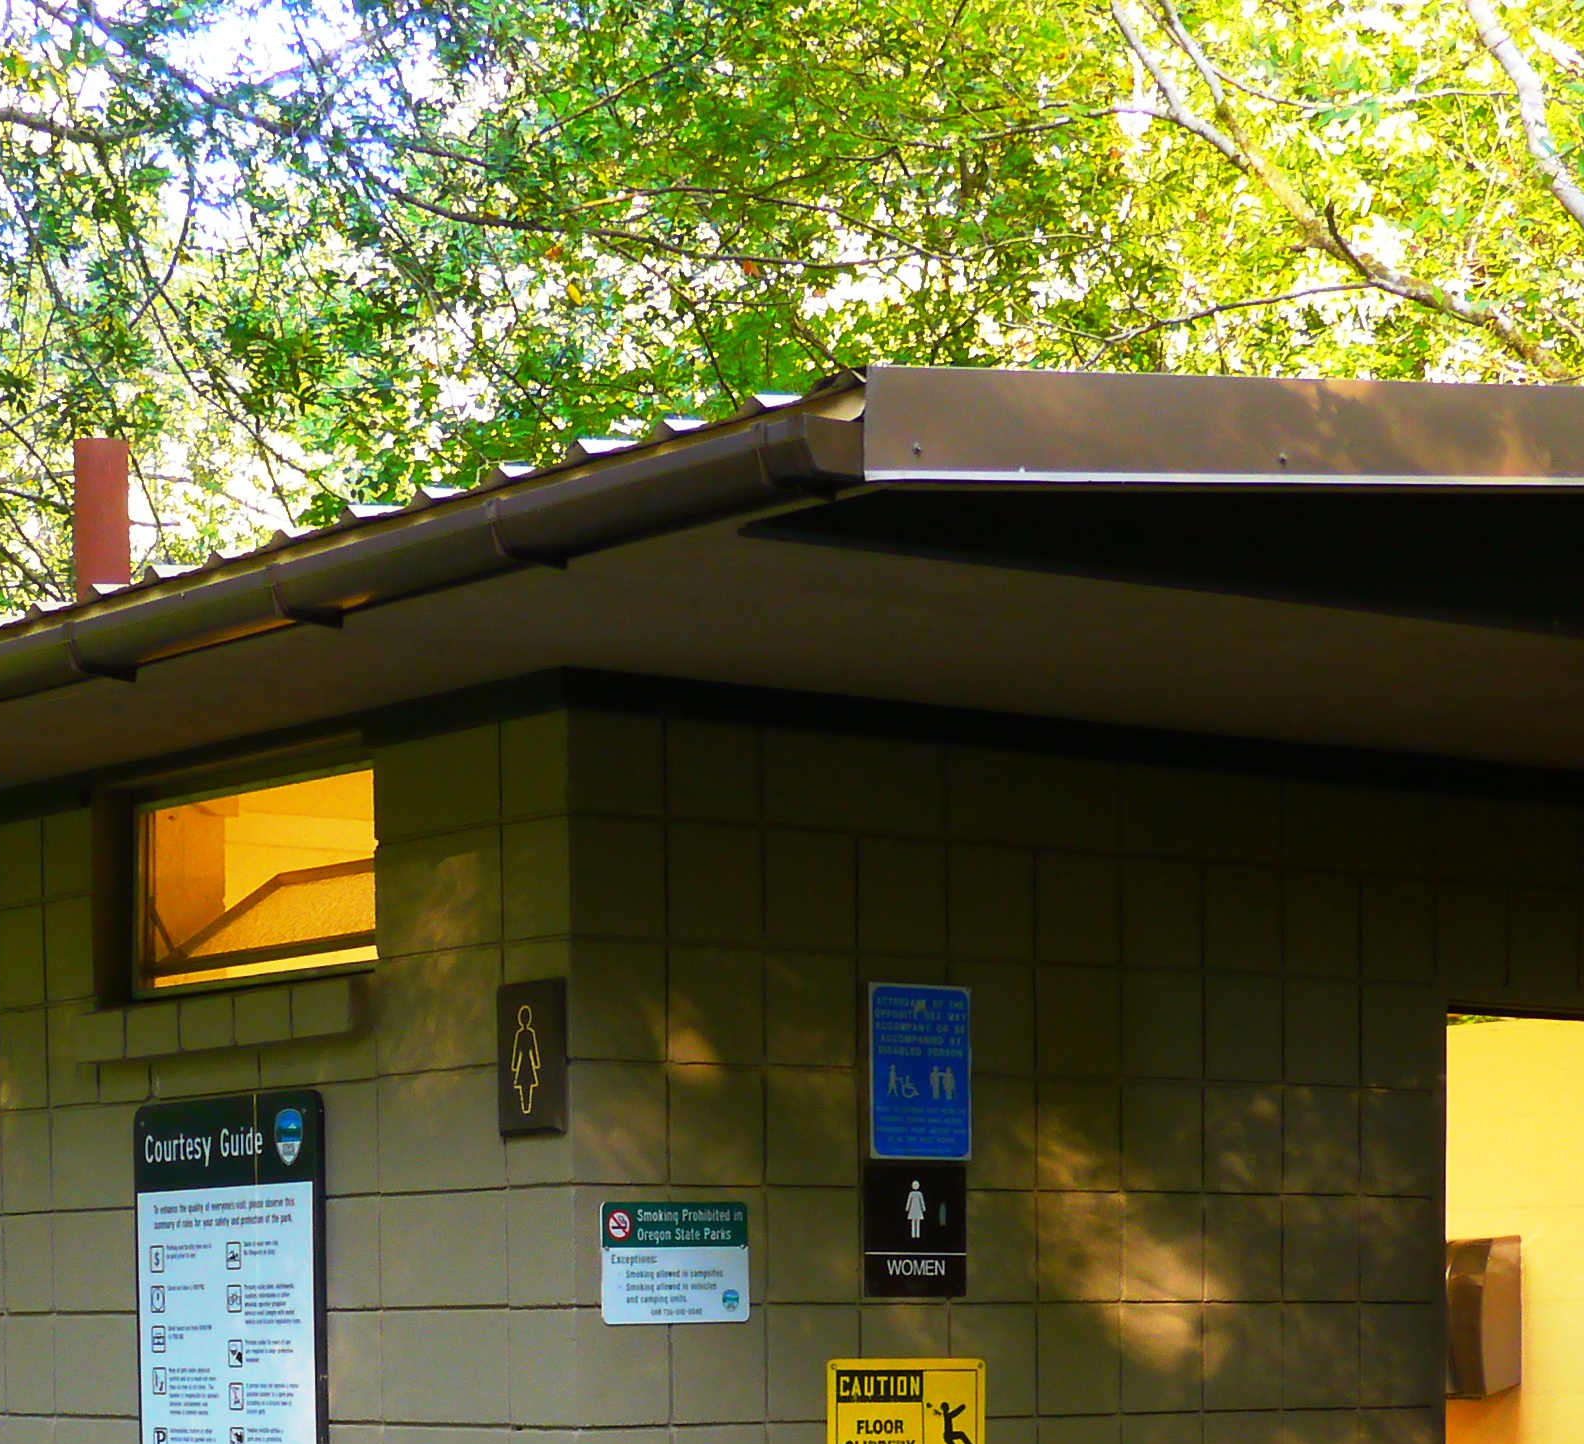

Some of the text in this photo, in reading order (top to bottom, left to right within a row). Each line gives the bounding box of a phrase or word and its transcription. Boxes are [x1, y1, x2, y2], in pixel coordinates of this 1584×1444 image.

[948, 1000, 965, 1010] THE
[947, 1012, 968, 1022] MAY
[875, 1021, 966, 1035] ACCOMPANY OR BE
[880, 1034, 962, 1046] ACCOMPANIED BY
[878, 1045, 964, 1058] DISABLED PERSON
[145, 1133, 212, 1167] Courtesy
[220, 1126, 263, 1157] Guide
[637, 1208, 743, 1226] Smoking Prohibited in
[637, 1226, 731, 1245] Oregon State Parks
[611, 1254, 658, 1266] Exceptions:
[626, 1269, 655, 1280] Smoking
[656, 1269, 681, 1278] allowed
[691, 1268, 724, 1280] campsites
[887, 1259, 946, 1276] WOMEN
[626, 1282, 655, 1293] Smoking
[656, 1282, 681, 1291] allowed
[626, 1295, 638, 1304] and
[640, 1295, 668, 1305] camping
[840, 1376, 920, 1396] CAUTION
[857, 1419, 904, 1434] FLOOR
